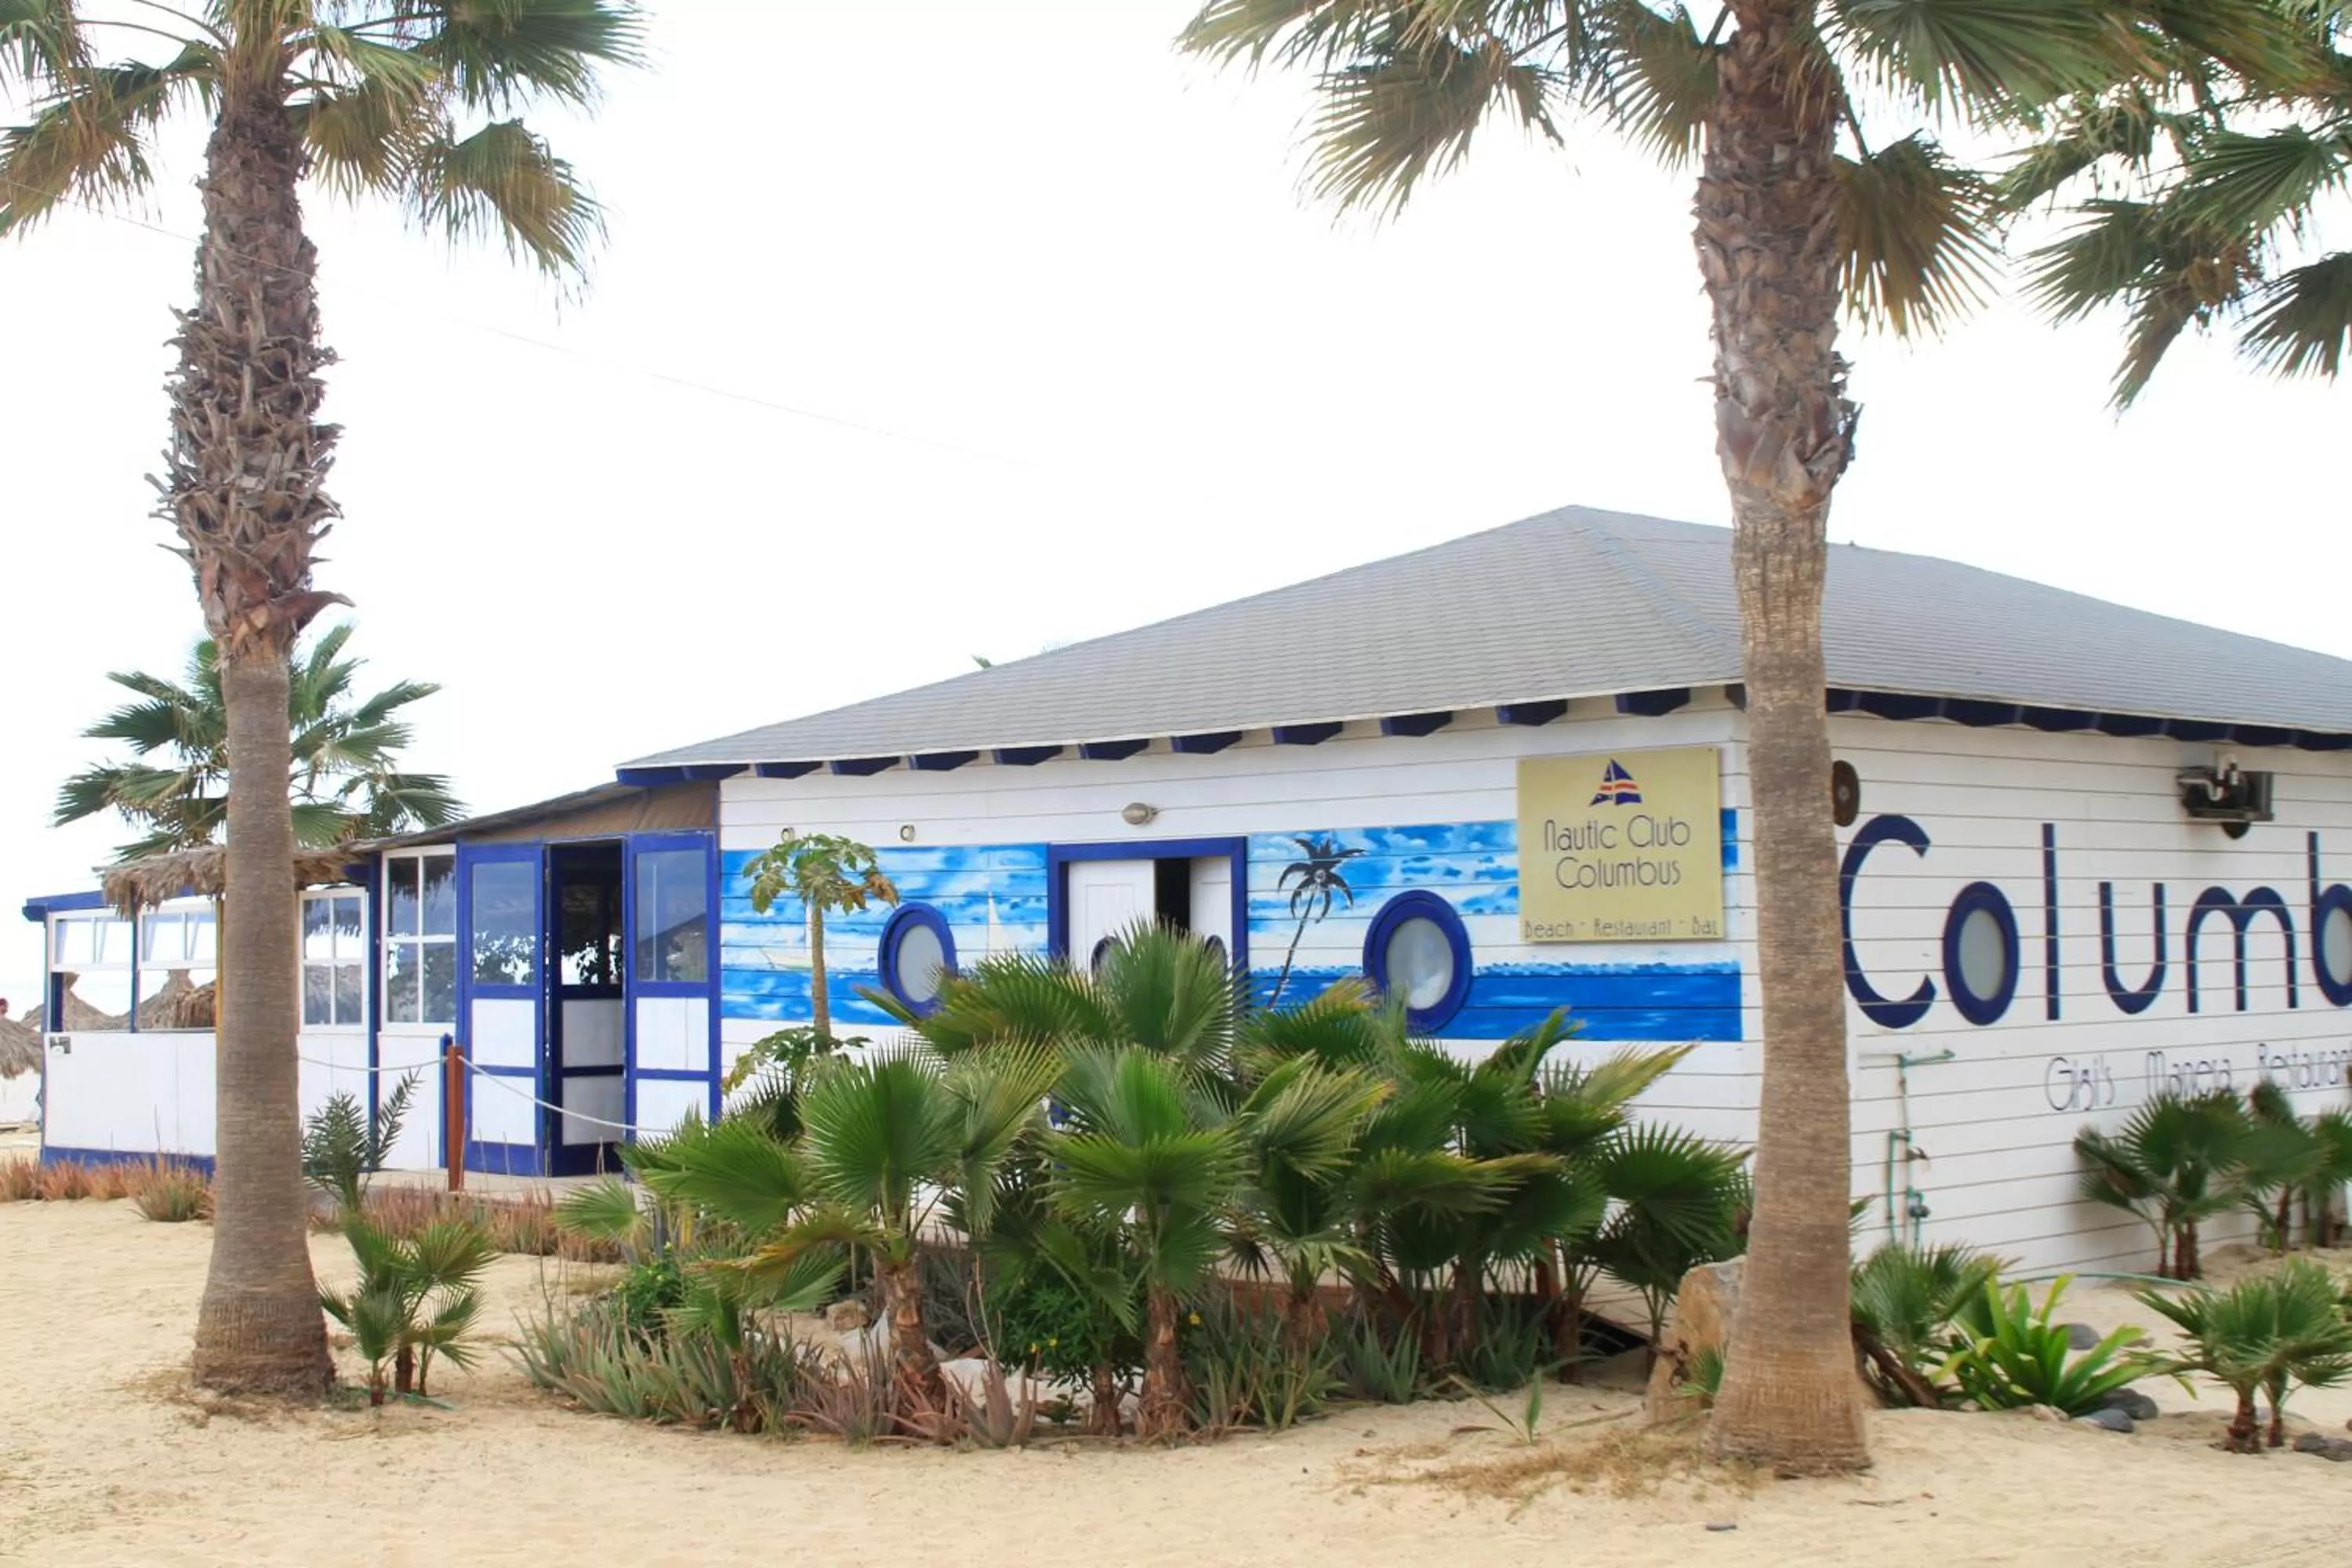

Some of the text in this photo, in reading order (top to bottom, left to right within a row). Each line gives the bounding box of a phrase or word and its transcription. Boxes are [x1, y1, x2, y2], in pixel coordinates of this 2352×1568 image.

[1544, 815, 1691, 852] Nautic Club
[1555, 856, 1682, 889] Columbus
[1524, 915, 1719, 939] Beach Restaurant Bar
